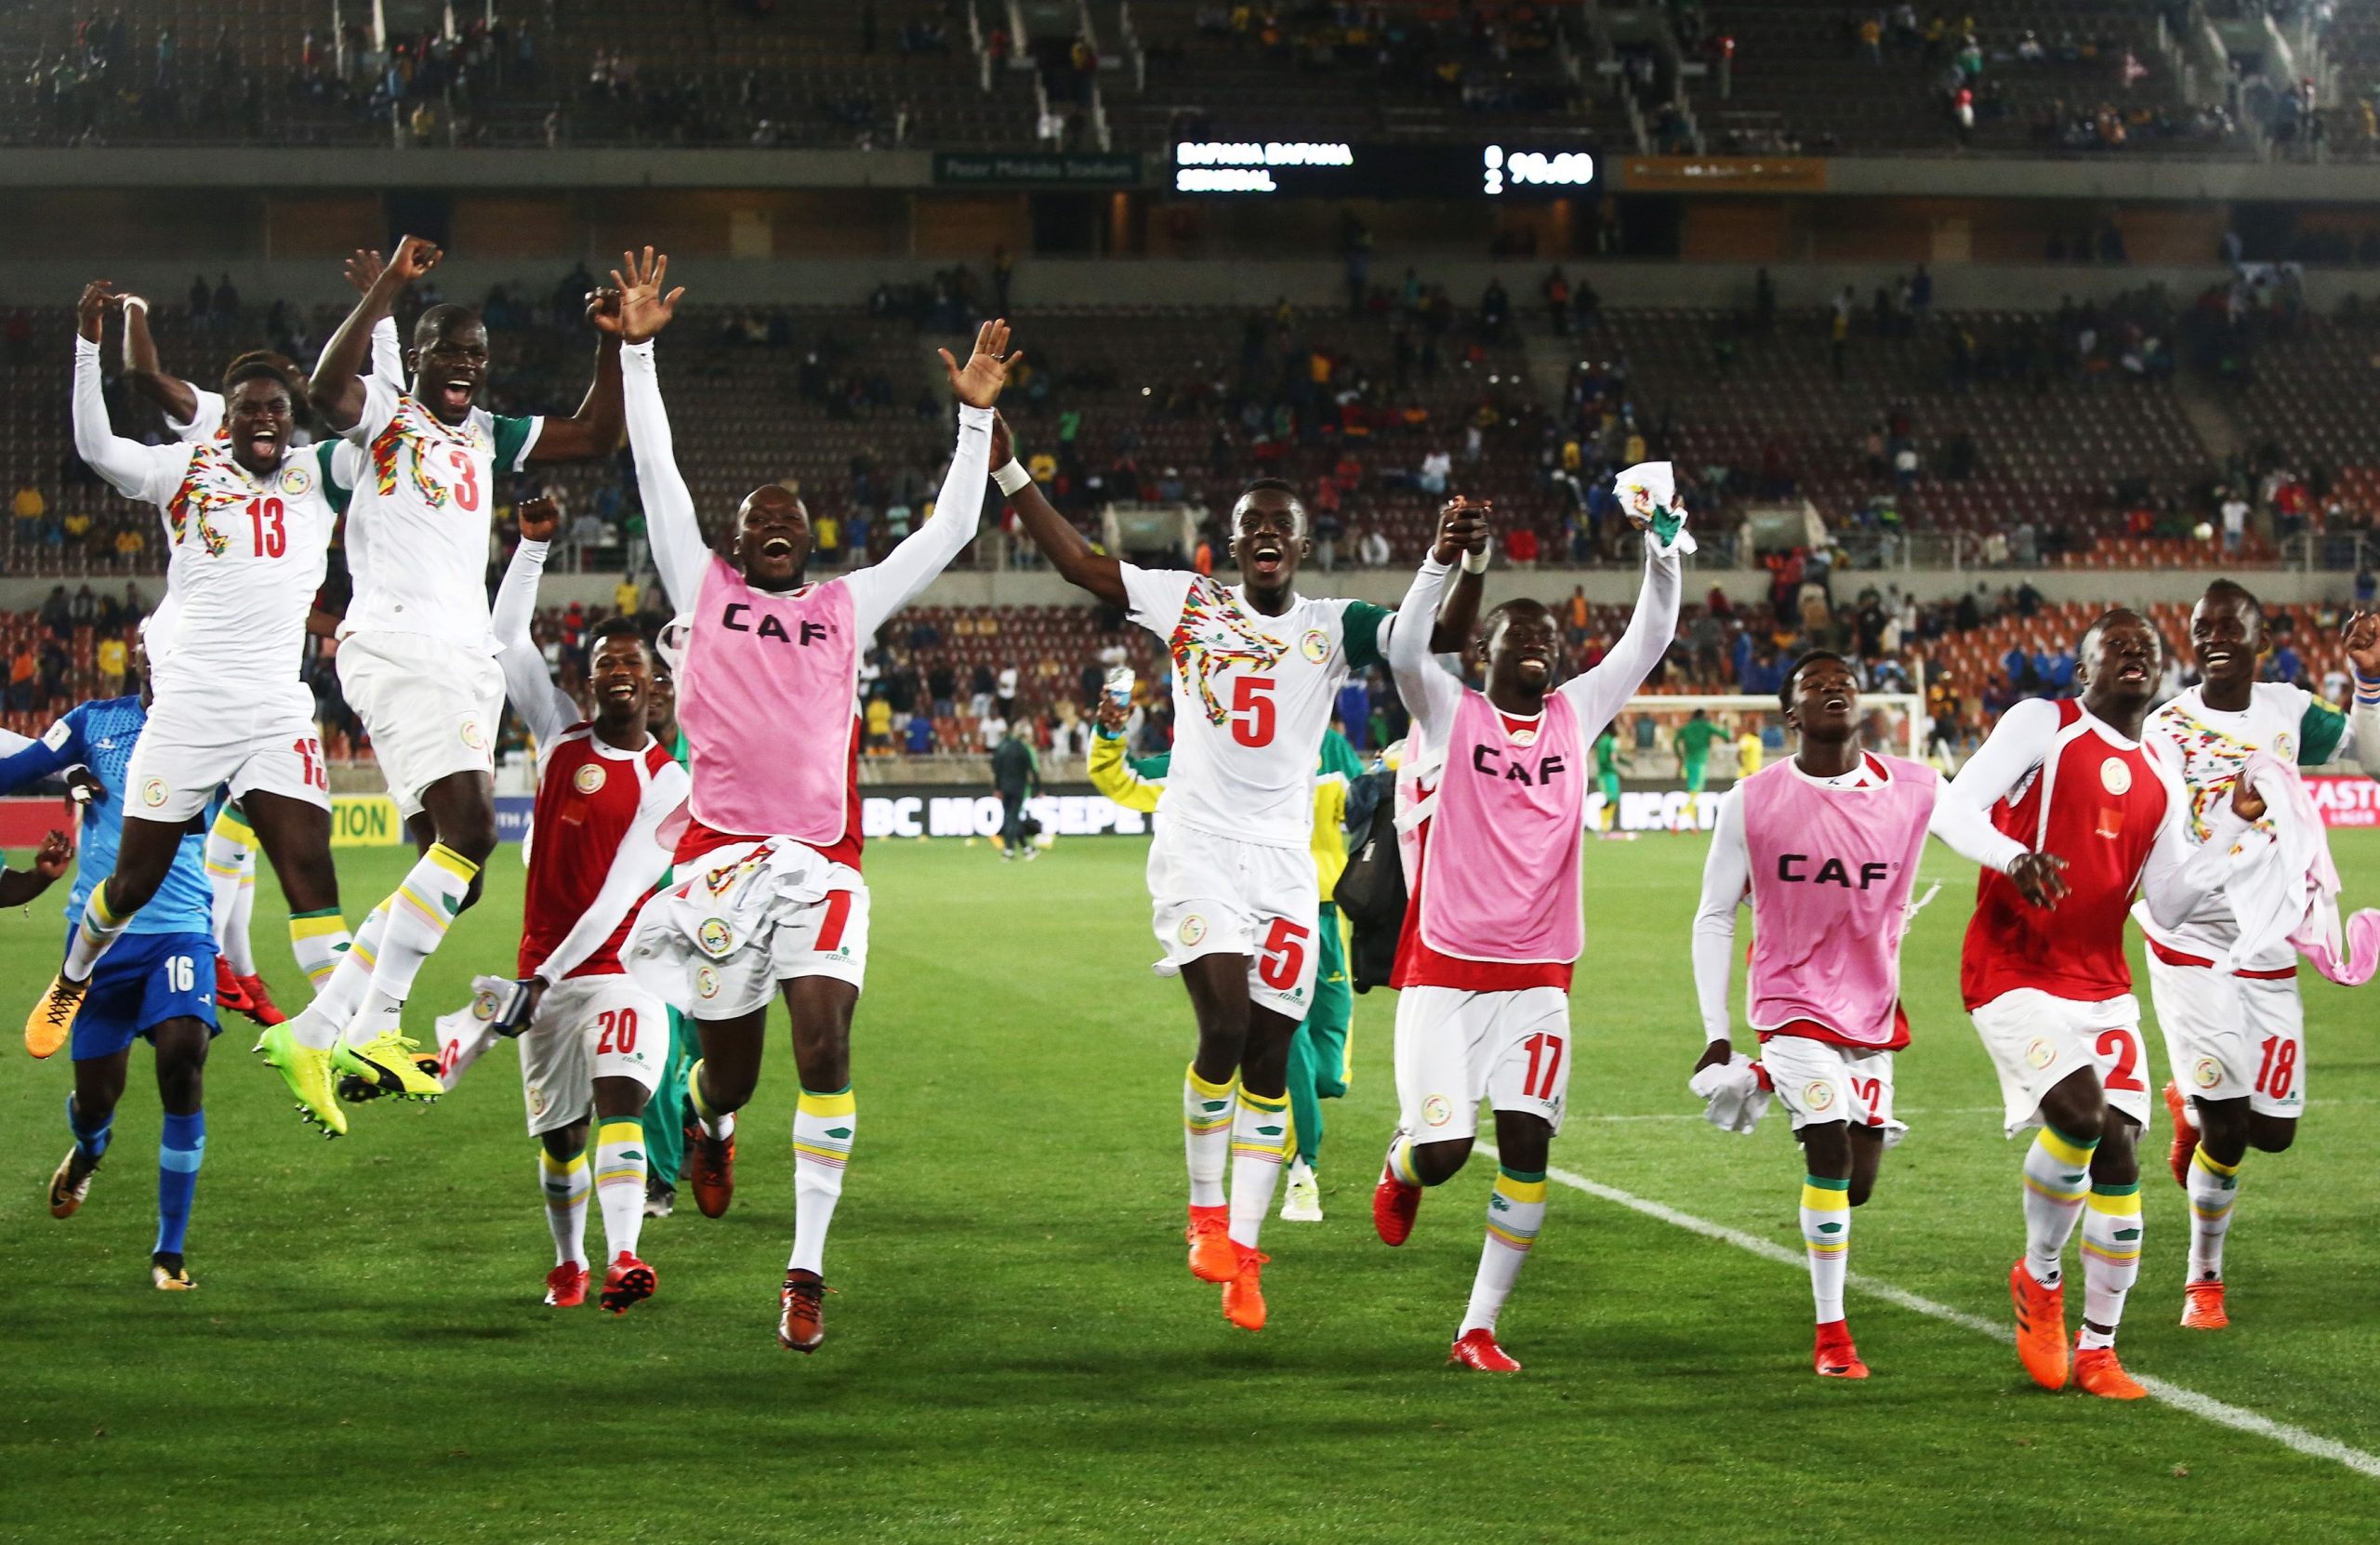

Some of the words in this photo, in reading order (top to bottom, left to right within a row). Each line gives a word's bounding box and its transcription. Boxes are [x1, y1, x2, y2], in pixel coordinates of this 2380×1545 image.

[449, 450, 480, 512] 3
[245, 497, 286, 558] 13
[722, 602, 828, 647] CAF
[1231, 676, 1276, 748] 5
[1474, 744, 1566, 786] CAF
[1778, 853, 1887, 890] CAF
[165, 955, 194, 994] 16
[1259, 917, 1310, 991] 5
[596, 1007, 638, 1055] 20
[2096, 1029, 2145, 1092] 2
[1523, 1032, 1564, 1100] 17
[2254, 1035, 2296, 1100] 18
